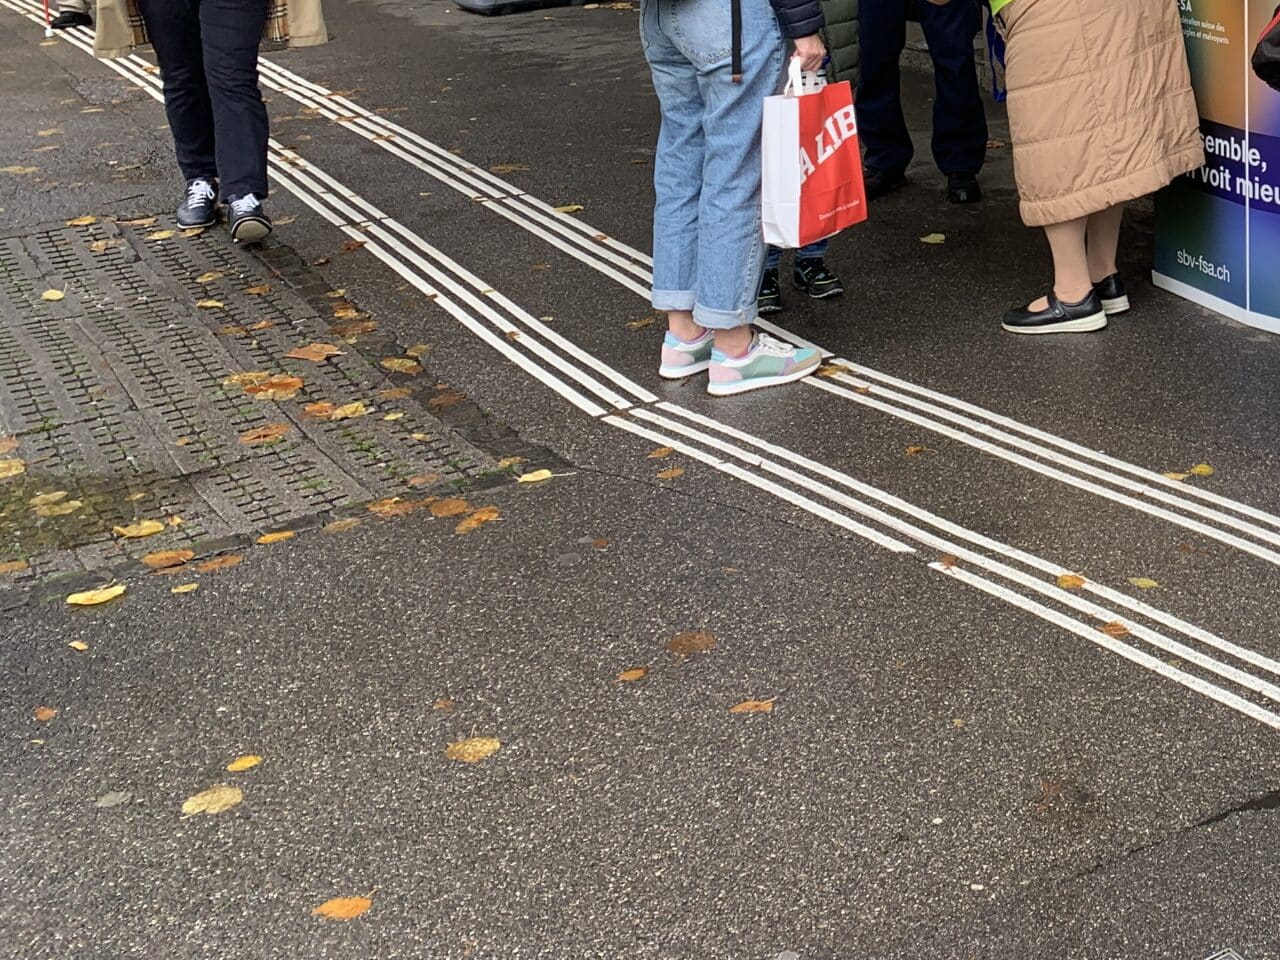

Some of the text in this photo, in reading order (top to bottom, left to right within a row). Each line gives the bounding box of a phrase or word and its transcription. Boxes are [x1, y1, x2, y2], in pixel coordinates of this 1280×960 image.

[1216, 21, 1226, 33] des
[1201, 165, 1232, 192] voit
[1177, 248, 1231, 284] sbv-fsa.ch
